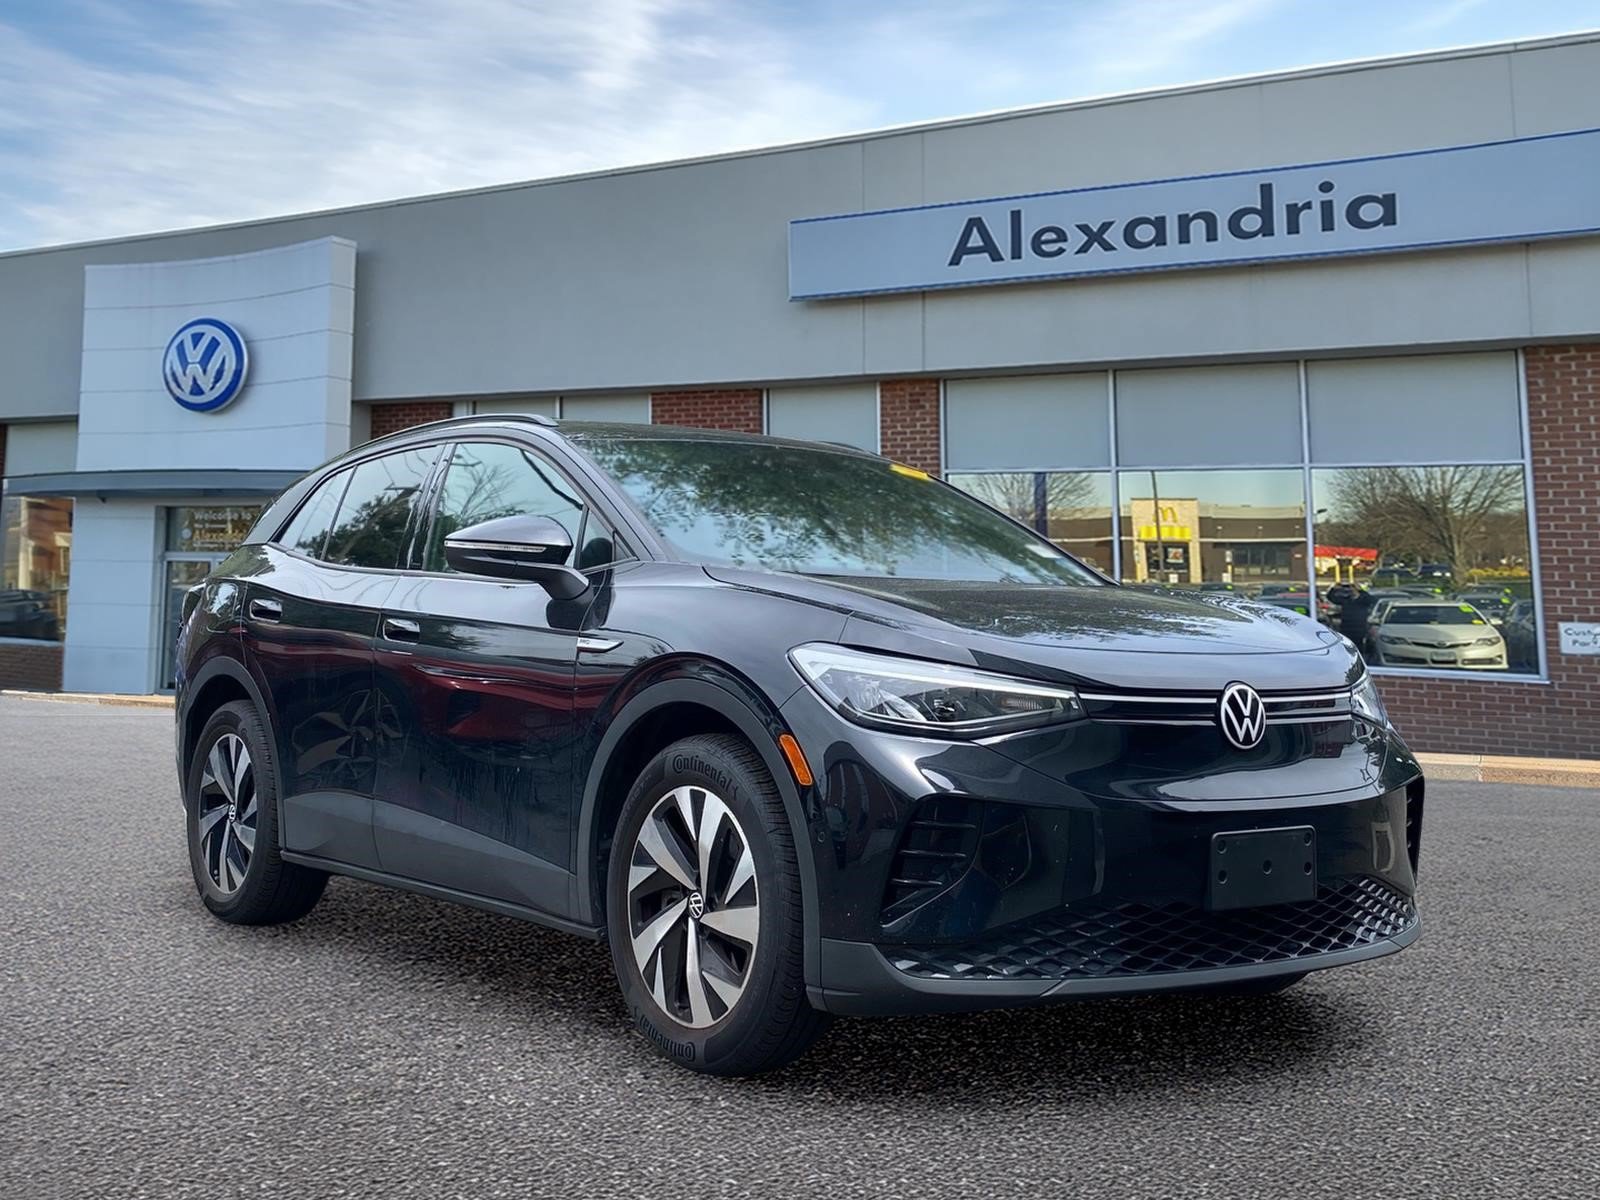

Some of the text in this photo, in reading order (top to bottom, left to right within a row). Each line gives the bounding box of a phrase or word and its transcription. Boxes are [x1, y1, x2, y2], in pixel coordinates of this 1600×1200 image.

[947, 180, 1399, 267] Alexandria
[165, 322, 237, 405] VW
[193, 529, 247, 541] Alexandr
[194, 510, 240, 521] Welcome
[1221, 684, 1266, 750] VW
[672, 754, 733, 793] Continental
[640, 1014, 696, 1062] Continental
